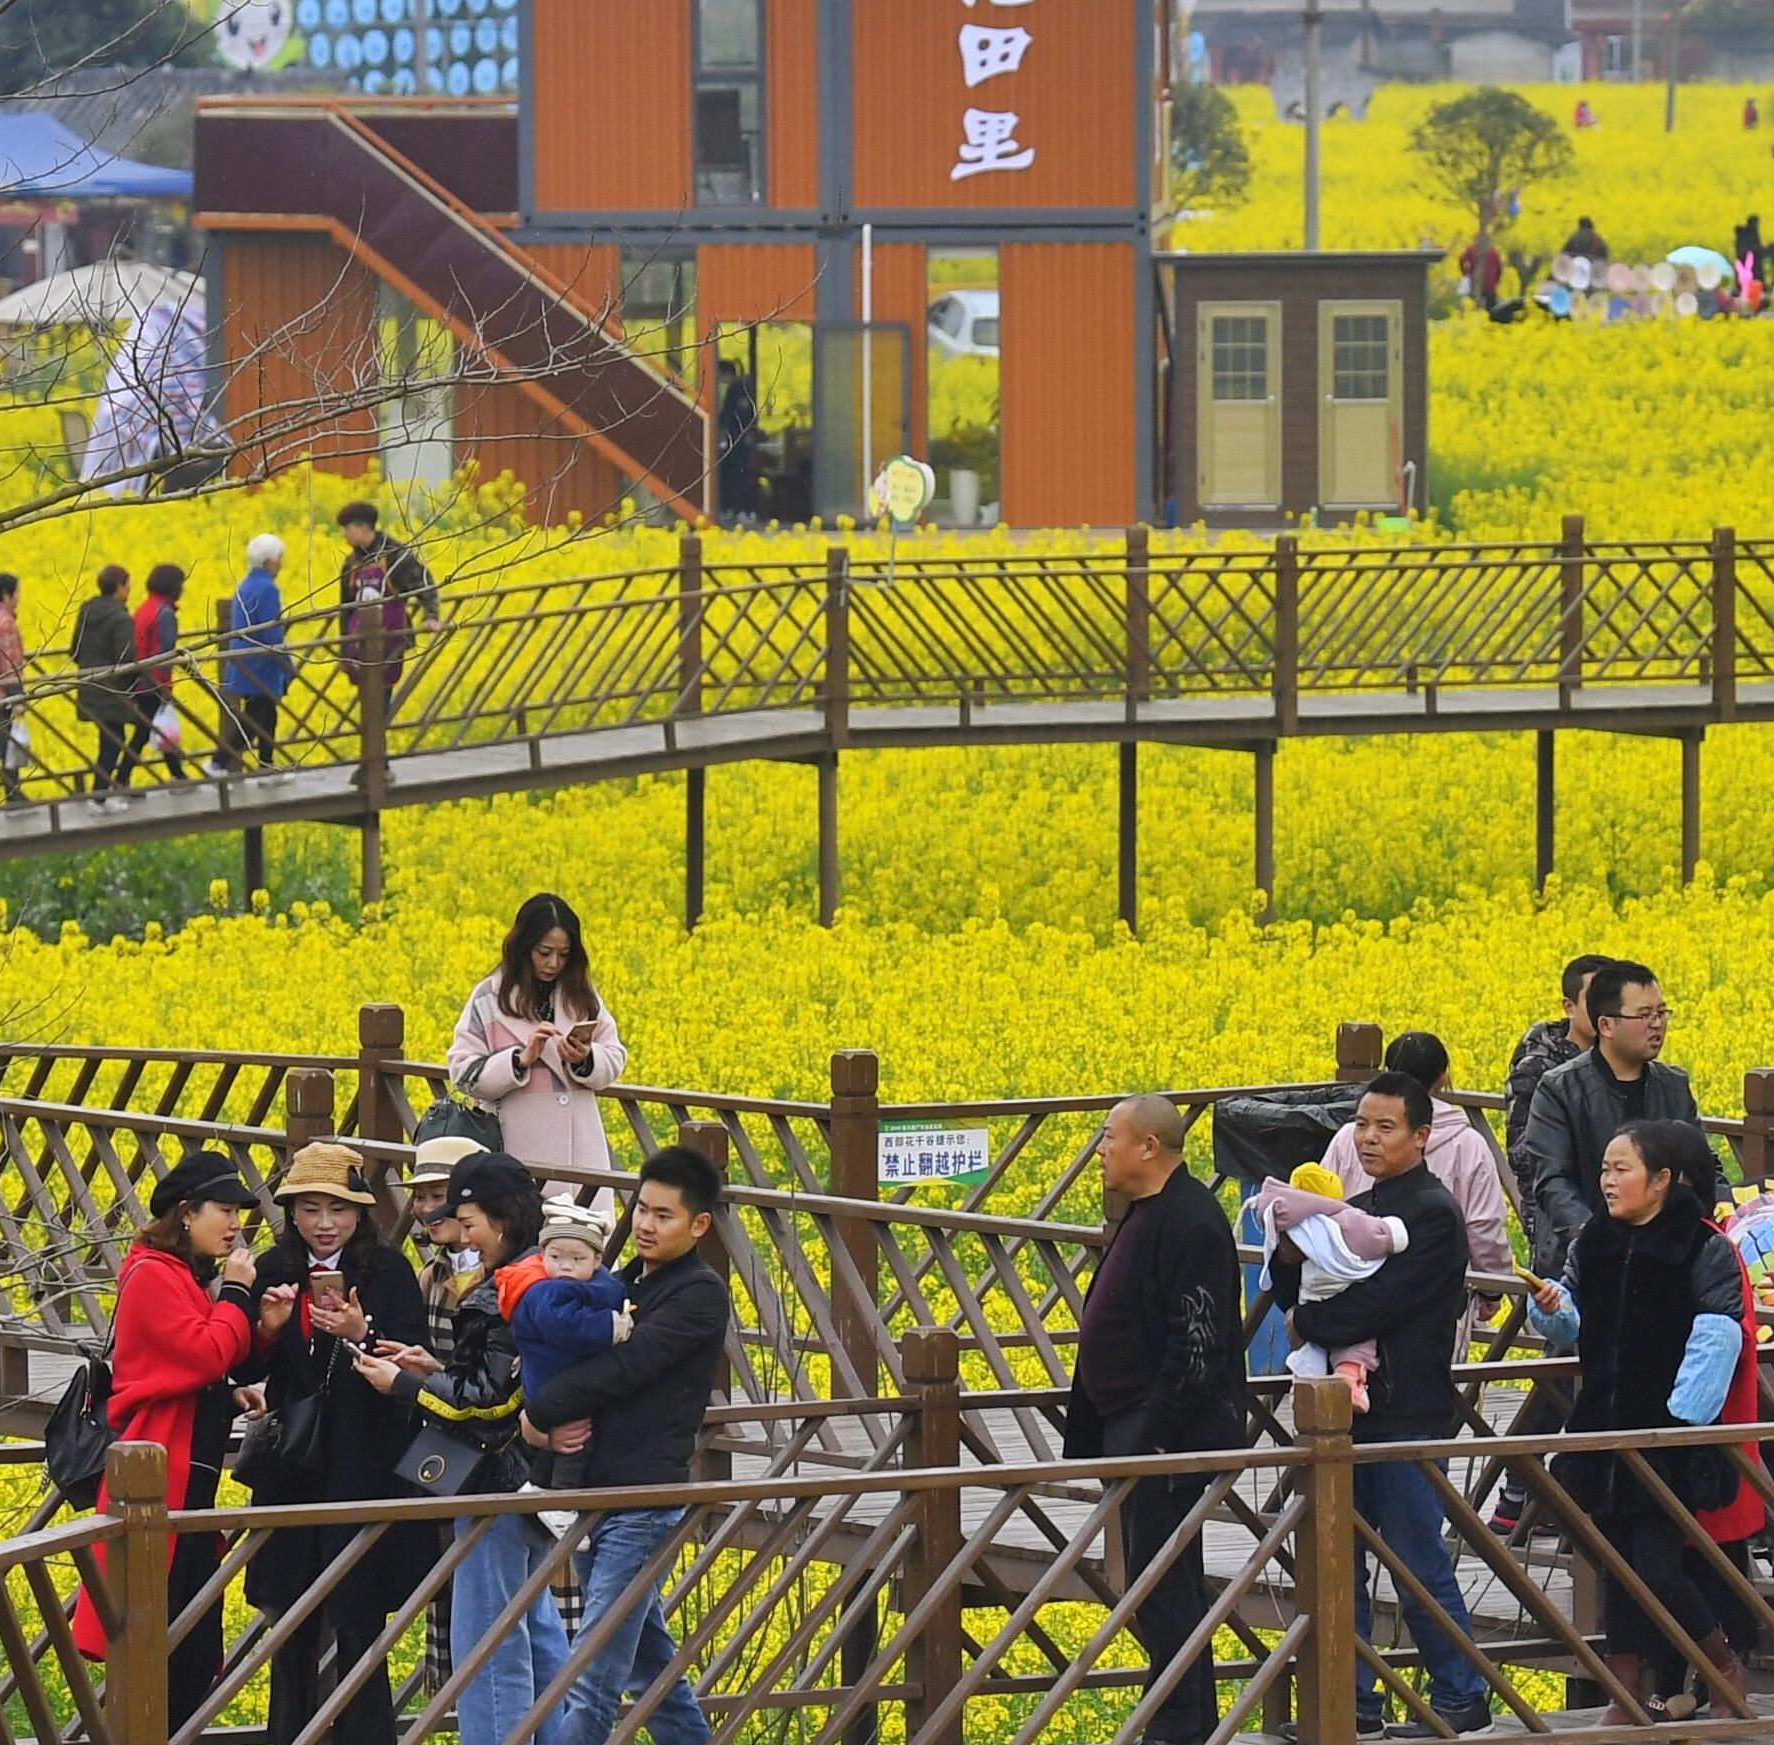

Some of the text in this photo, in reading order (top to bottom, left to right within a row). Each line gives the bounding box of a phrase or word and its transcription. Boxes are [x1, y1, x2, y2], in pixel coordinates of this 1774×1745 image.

[950, 0, 1036, 182] 田里
[884, 1150, 982, 1178] 禁止翻越护栏
